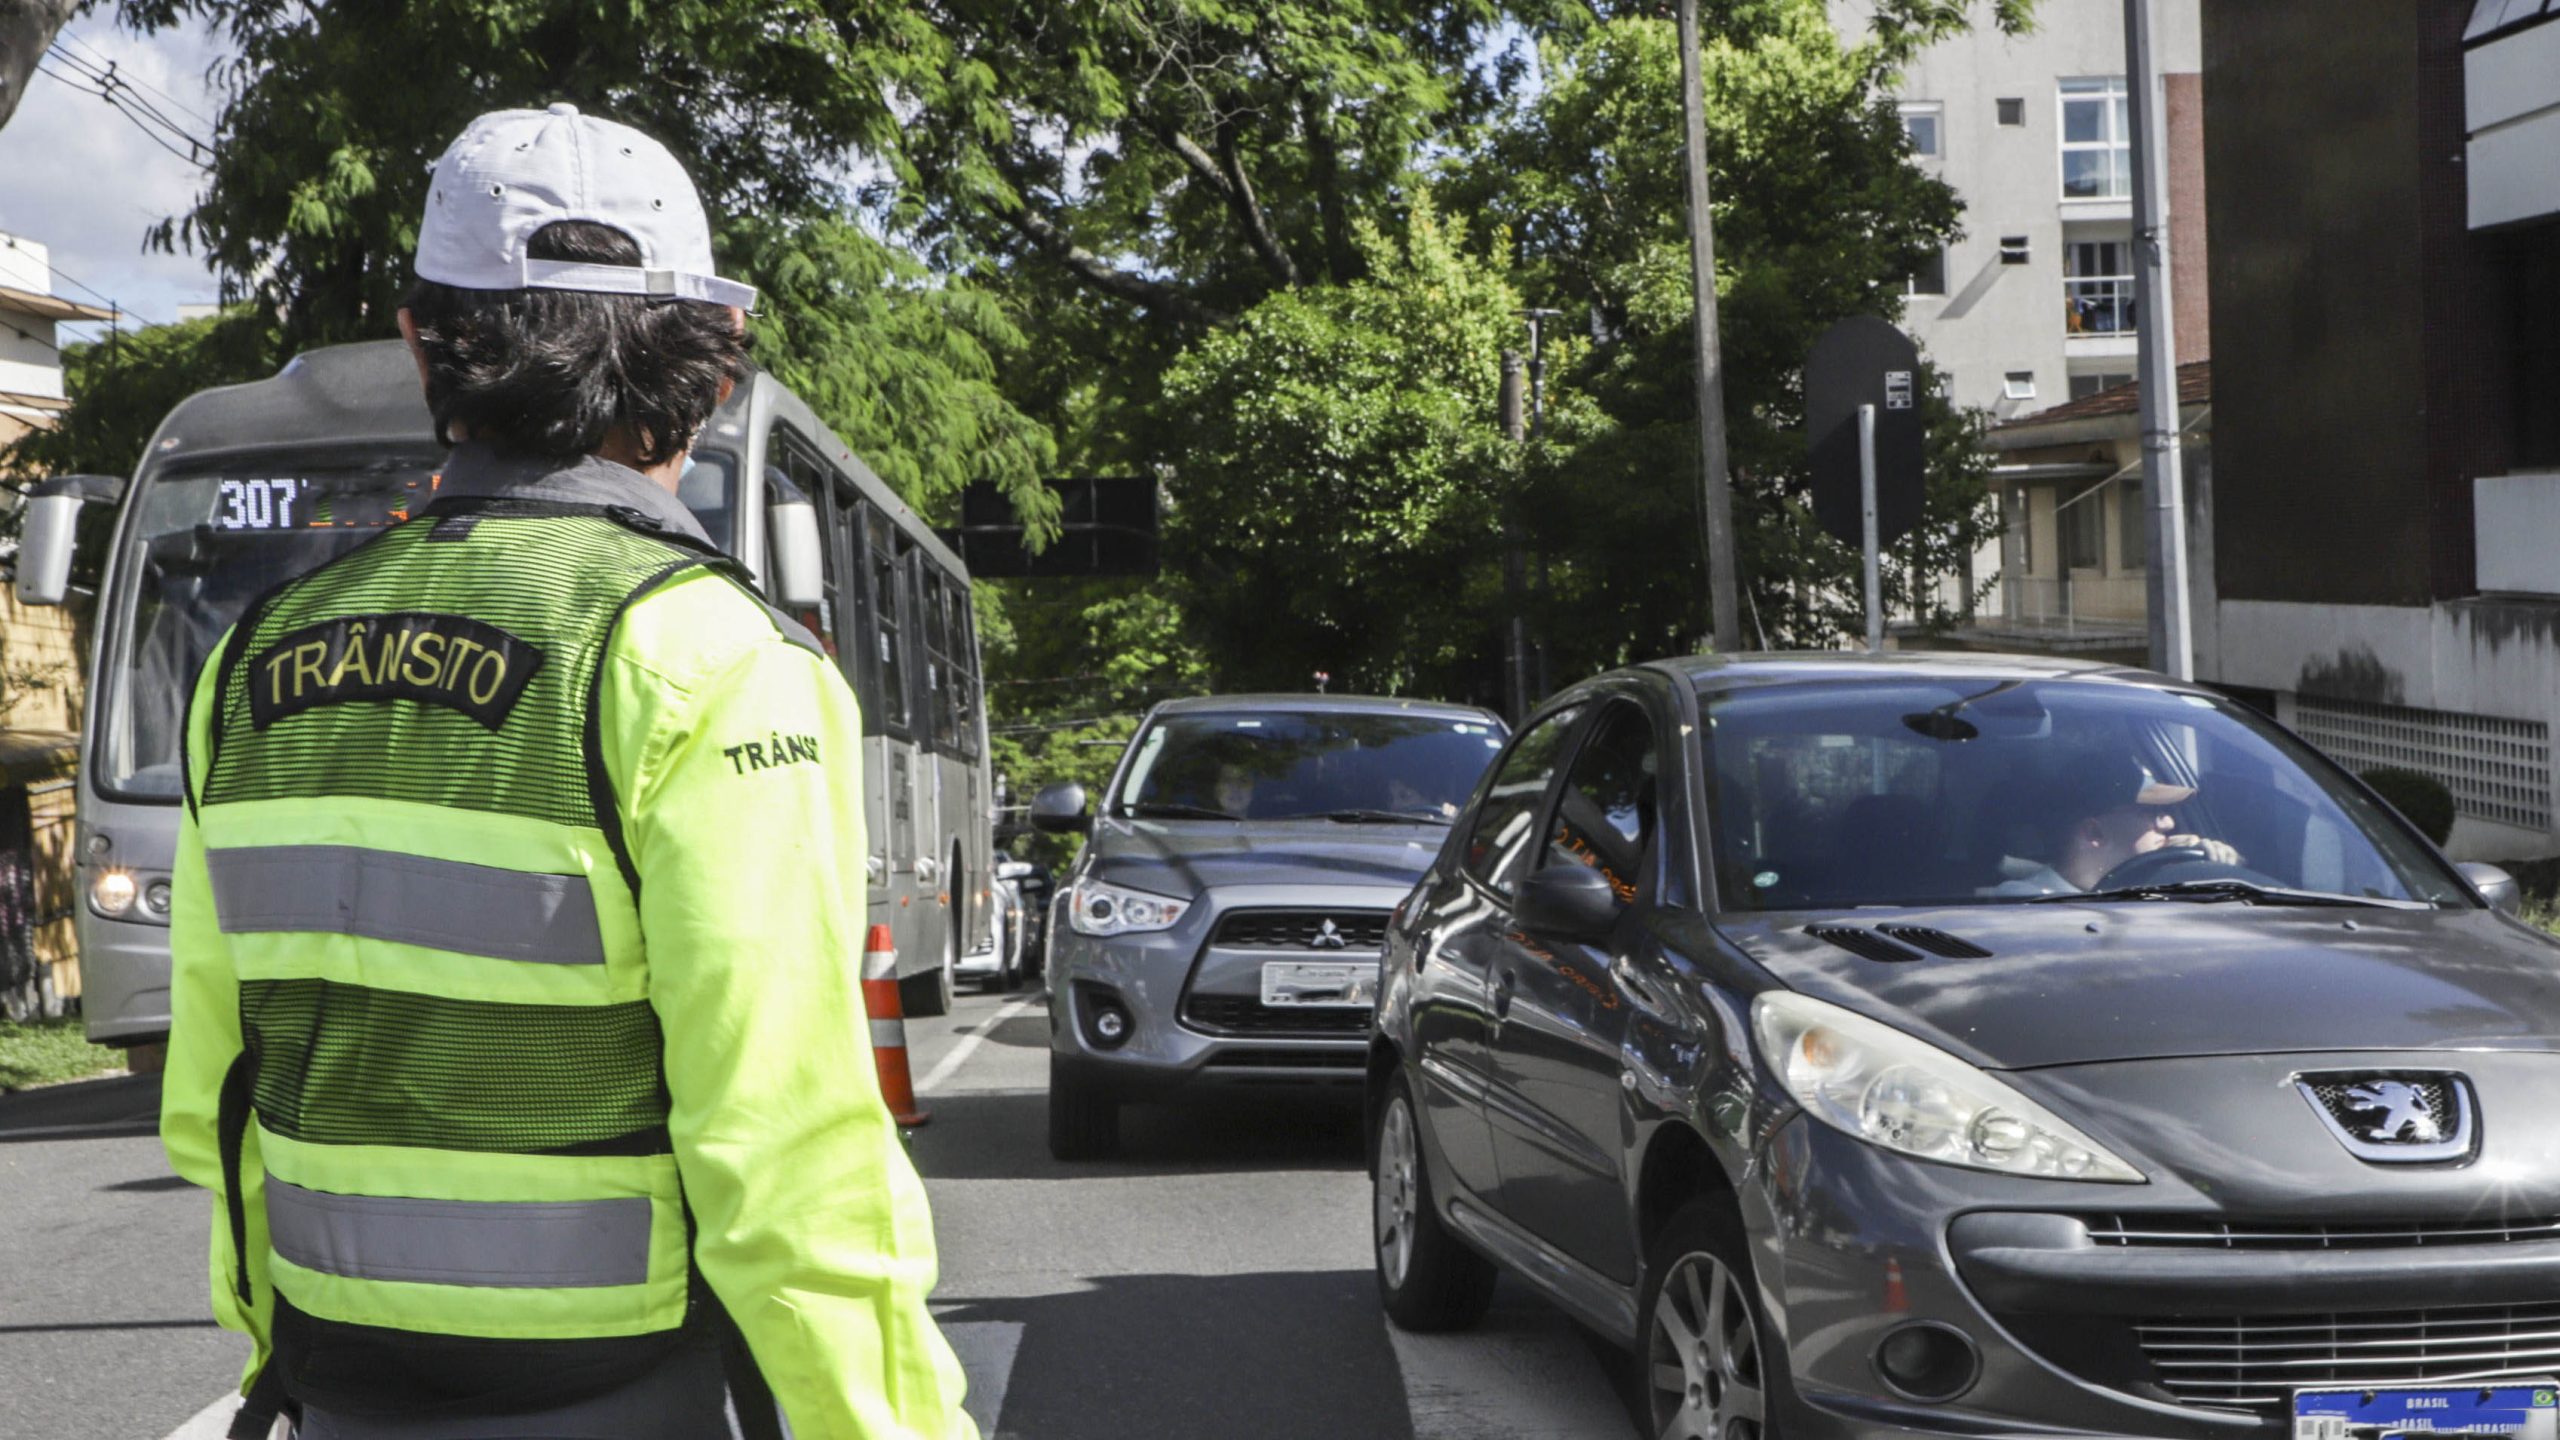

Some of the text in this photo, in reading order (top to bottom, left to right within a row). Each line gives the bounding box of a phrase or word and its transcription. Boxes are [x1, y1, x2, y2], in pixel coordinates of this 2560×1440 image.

[220, 478, 296, 529] 307
[266, 622, 506, 705] TRÂNSITO
[2406, 1397, 2449, 1409] BRASIL
